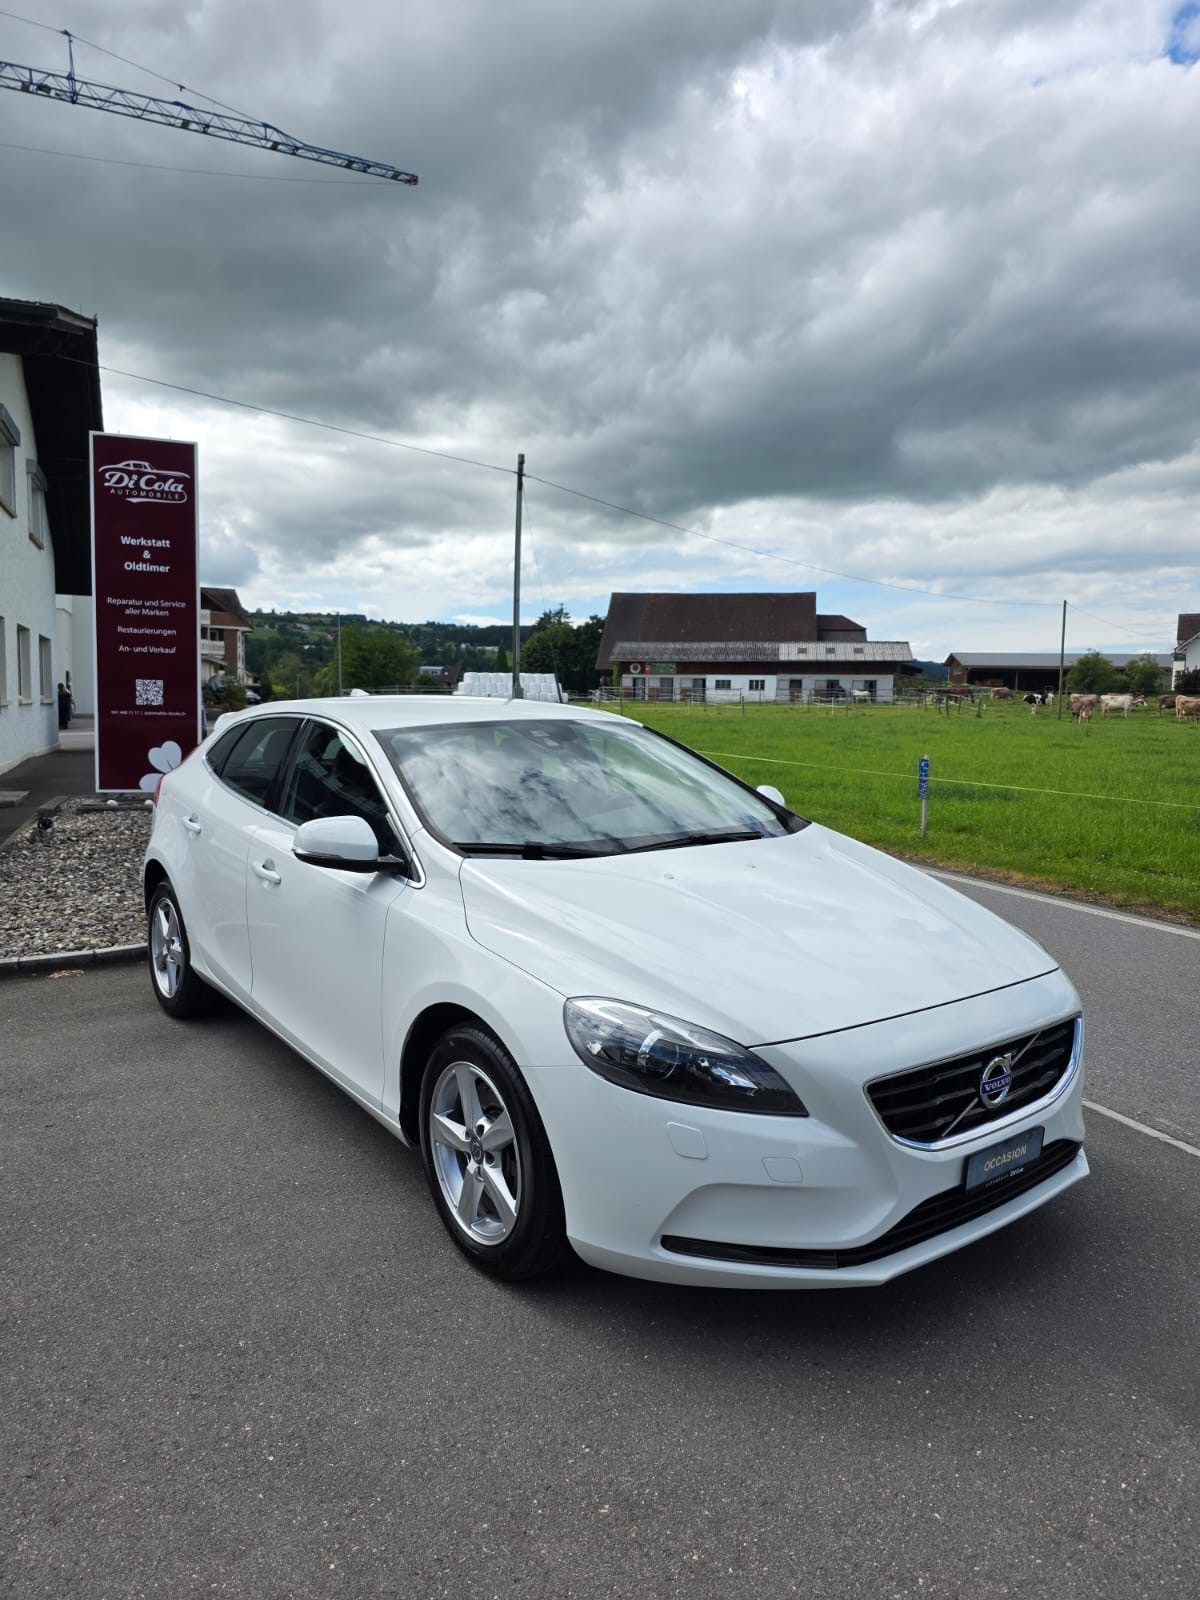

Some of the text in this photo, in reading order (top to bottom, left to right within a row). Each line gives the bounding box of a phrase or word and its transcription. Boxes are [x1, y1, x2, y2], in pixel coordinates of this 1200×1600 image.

[110, 488, 180, 500] AUTOMOBILE
[120, 535, 171, 548] Werkstatt
[142, 550, 151, 559] &
[124, 561, 171, 573] Oldtimer
[107, 596, 187, 608] Reparatur und Service
[124, 607, 169, 617] aller Marken
[117, 625, 177, 637] Restaurierungen
[118, 644, 177, 654] An- und Verkauf
[984, 1075, 1011, 1091] VOLVO
[983, 1144, 1027, 1172] OCCASION
